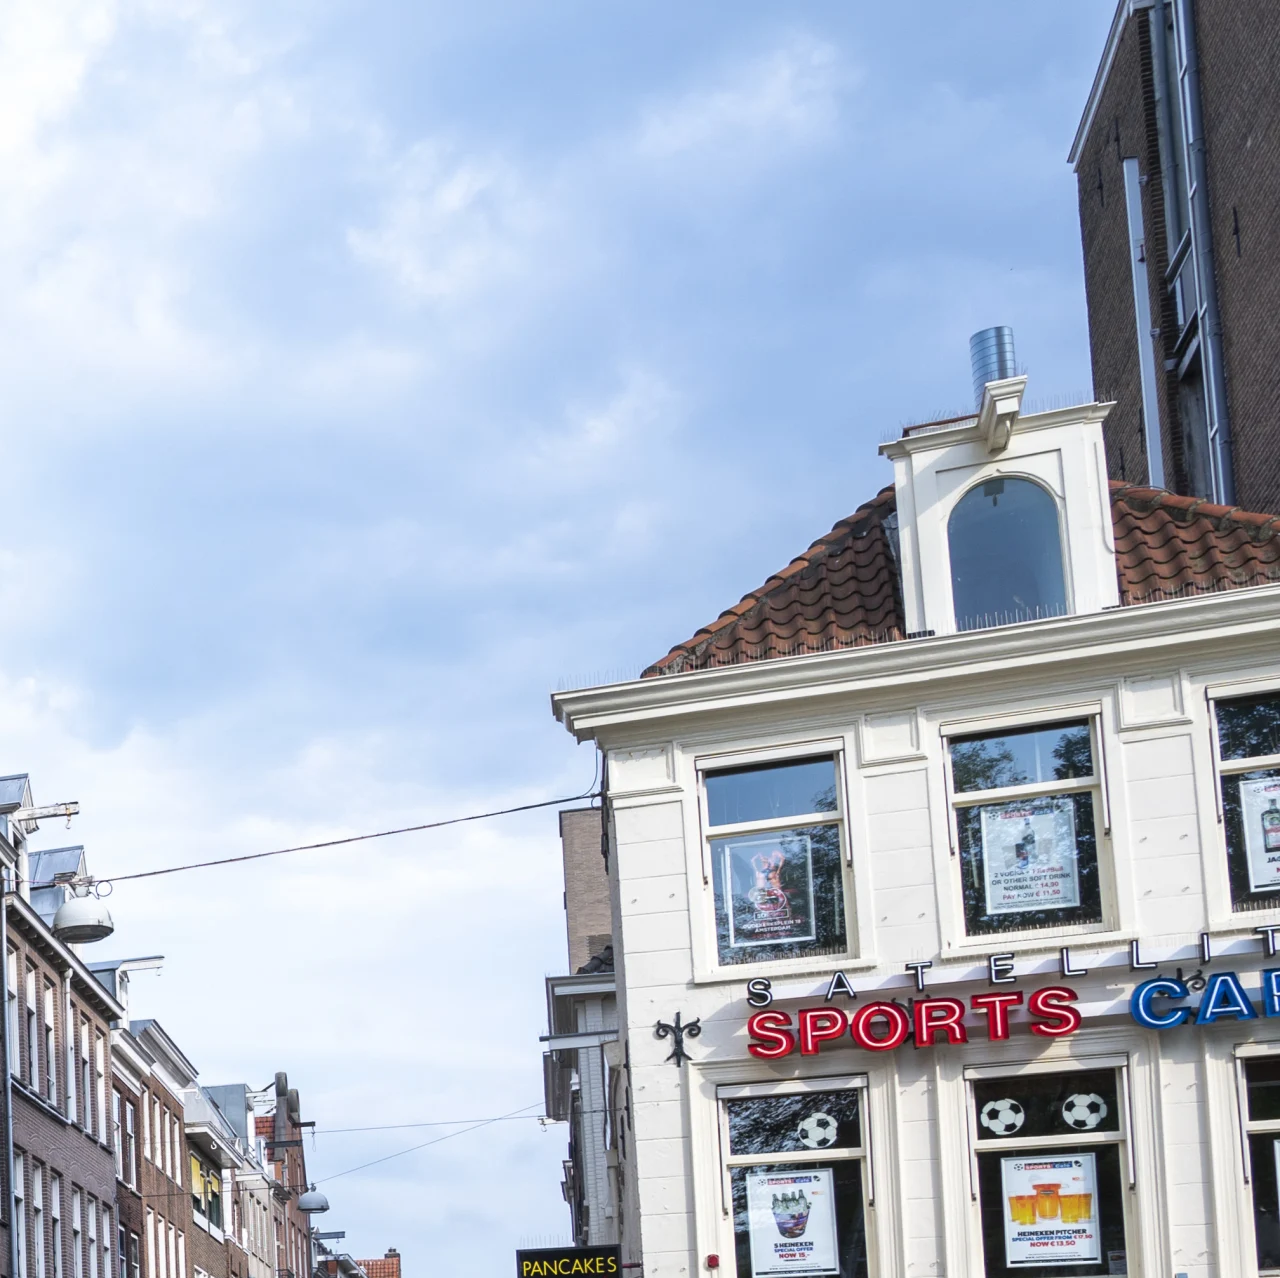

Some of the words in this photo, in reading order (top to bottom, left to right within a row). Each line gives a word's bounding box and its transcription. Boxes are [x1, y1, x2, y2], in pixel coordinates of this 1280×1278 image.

[1003, 877, 1028, 885] OTHER
[1049, 872, 1071, 880] DRINK
[1003, 884, 1033, 892] NORMAL
[755, 925, 791, 933] AMSTERDAM
[747, 986, 1083, 1060] SPORTS
[523, 1257, 618, 1278] PANCAKES
